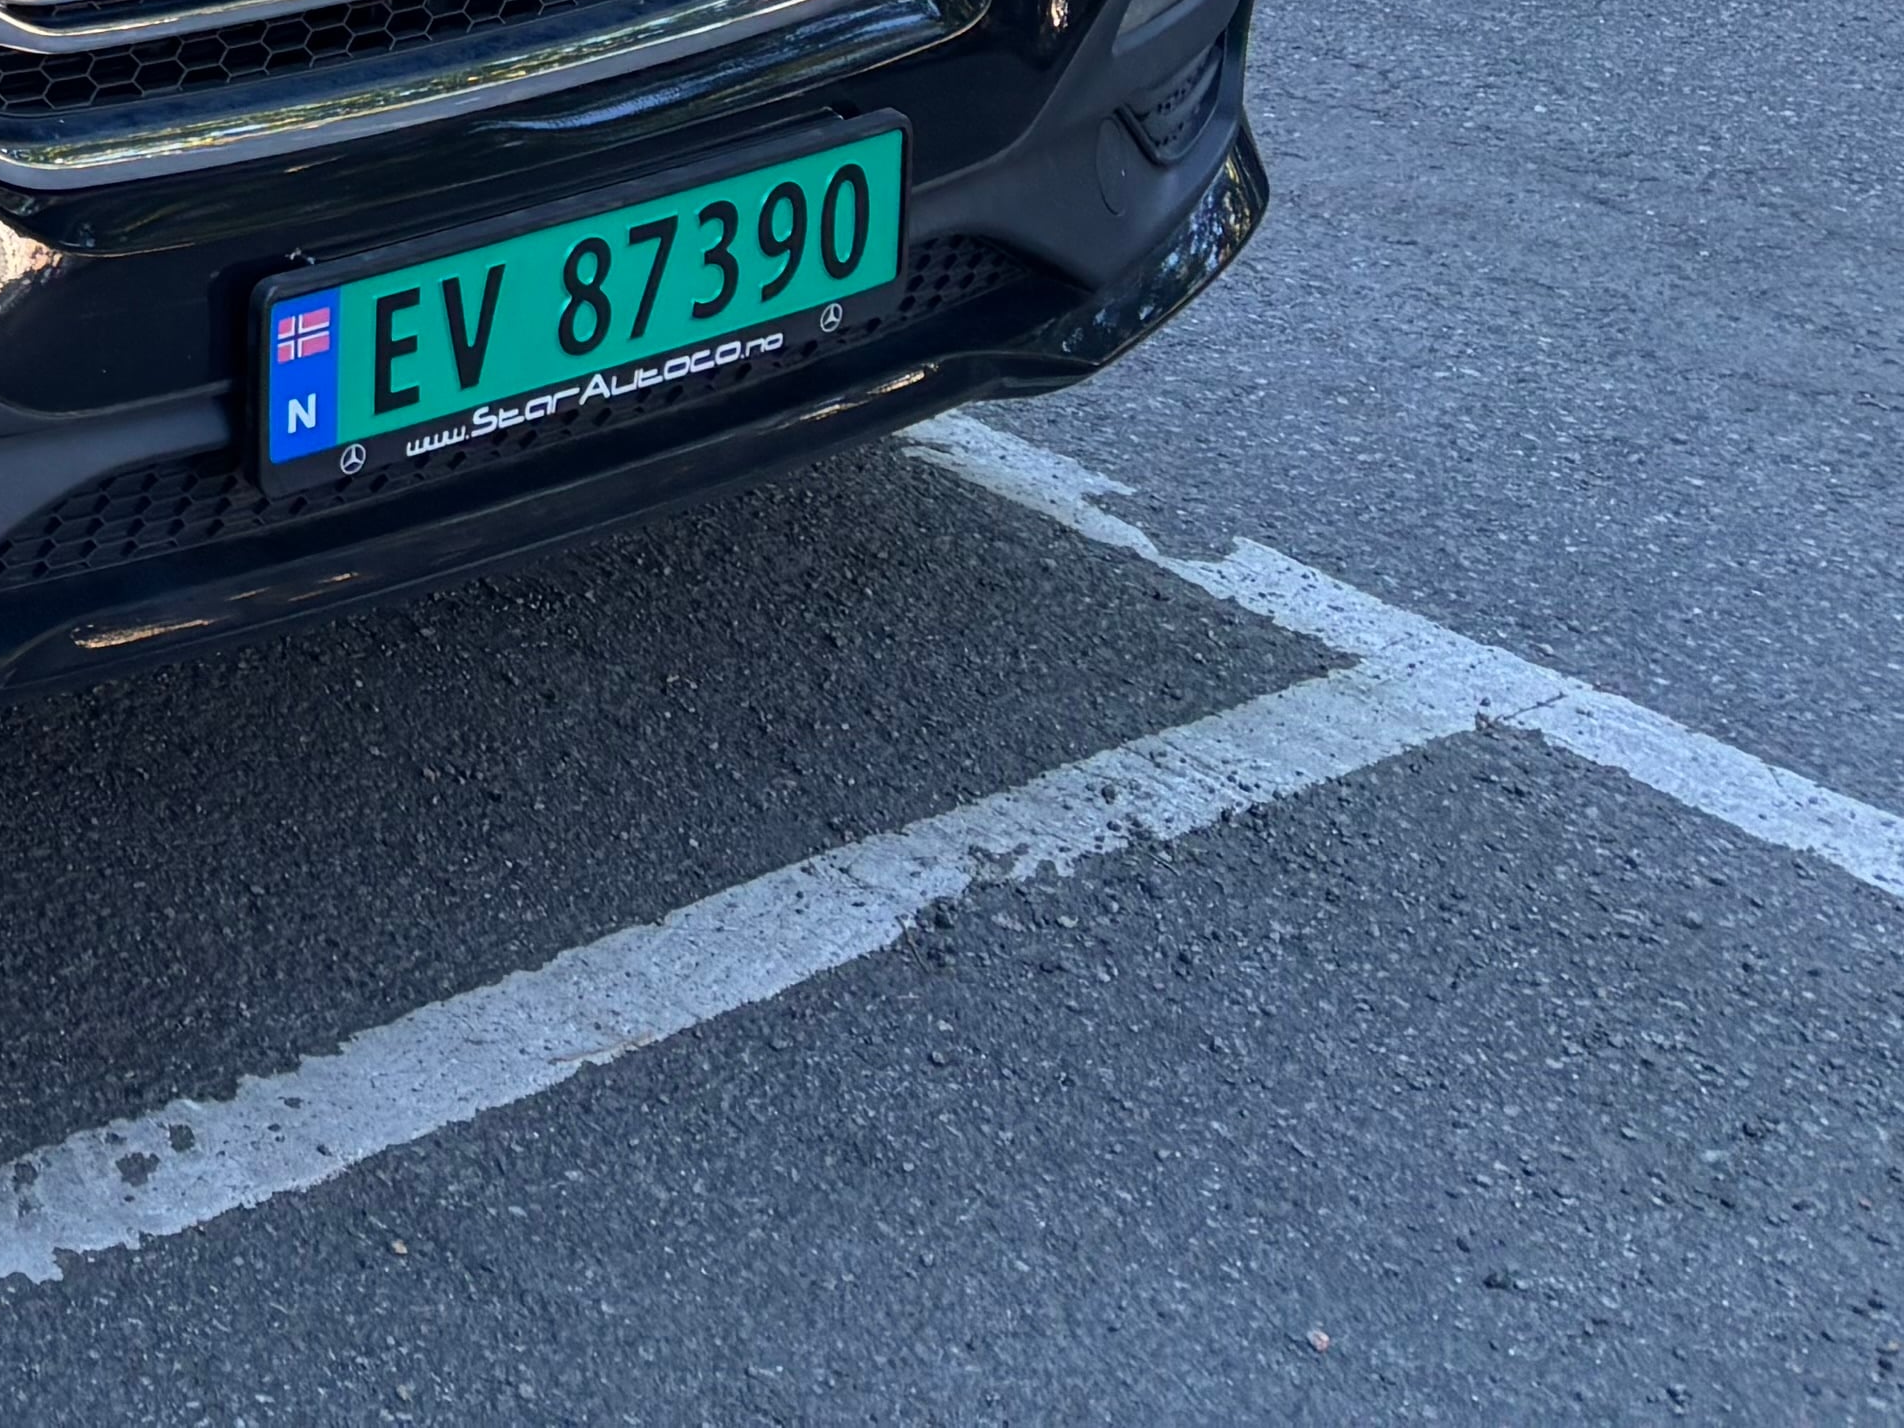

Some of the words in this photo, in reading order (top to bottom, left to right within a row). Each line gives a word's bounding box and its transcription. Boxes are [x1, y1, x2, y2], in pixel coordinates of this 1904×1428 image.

[373, 264, 507, 417] EV
[557, 162, 871, 358] 87390
[287, 393, 317, 434] N
